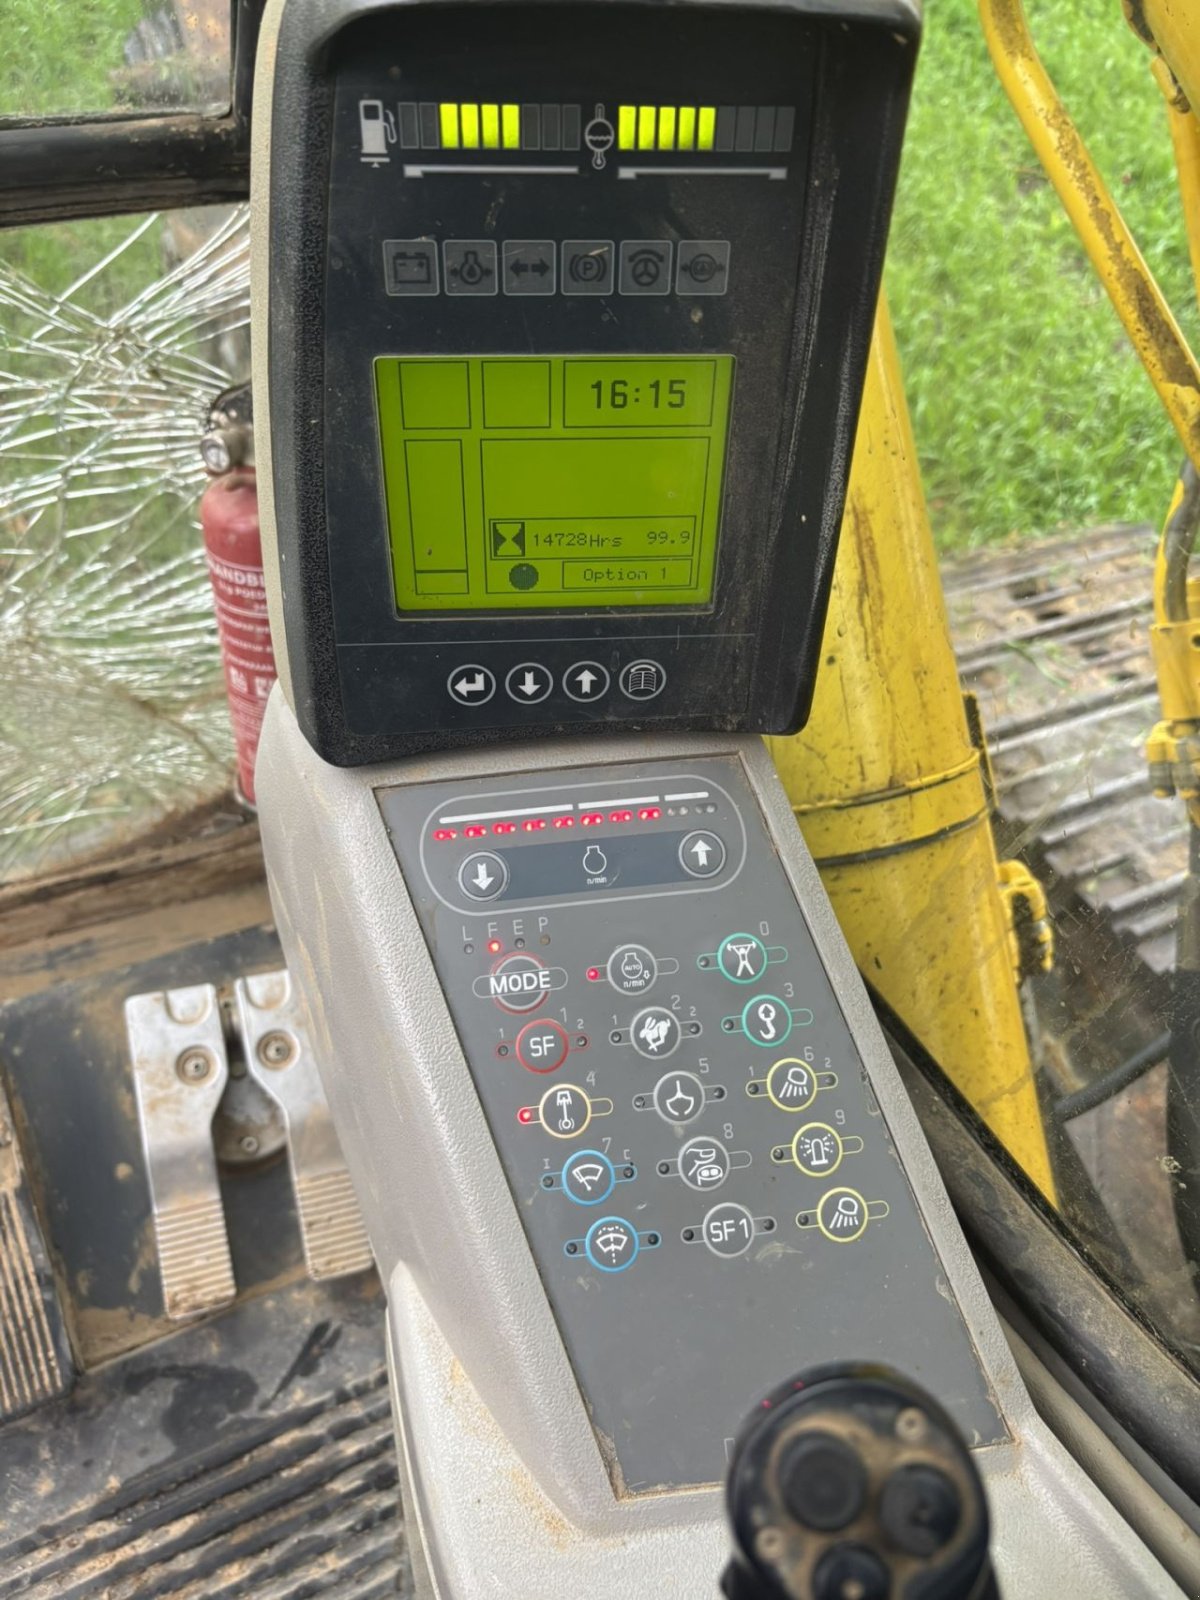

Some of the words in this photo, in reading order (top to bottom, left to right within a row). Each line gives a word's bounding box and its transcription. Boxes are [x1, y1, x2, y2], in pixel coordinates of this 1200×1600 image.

[591, 379, 686, 409] 16:15
[533, 532, 623, 548] 14728Hrs
[647, 531, 690, 545] 99.9
[583, 568, 648, 582] Option
[661, 567, 667, 580] 1
[462, 926, 473, 941] L
[487, 922, 498, 938] F
[512, 919, 524, 935] E
[538, 917, 549, 932] P
[489, 970, 551, 994] MODE
[623, 979, 645, 988] n/min
[784, 983, 794, 998] 3
[671, 995, 681, 1010] 2
[561, 1007, 568, 1023] 1
[689, 1006, 697, 1016] 2
[577, 1019, 584, 1030] 2
[612, 1015, 619, 1025] 1
[499, 1028, 505, 1038] 1
[529, 1035, 555, 1057] SF
[804, 1046, 814, 1062] 6
[699, 1057, 709, 1074] 5
[749, 1066, 755, 1076] 1
[825, 1058, 832, 1068] 2
[586, 1071, 596, 1087] 4
[835, 1109, 846, 1125] 9
[723, 1123, 734, 1140] 8
[602, 1137, 612, 1154] 7
[624, 1149, 631, 1160] C
